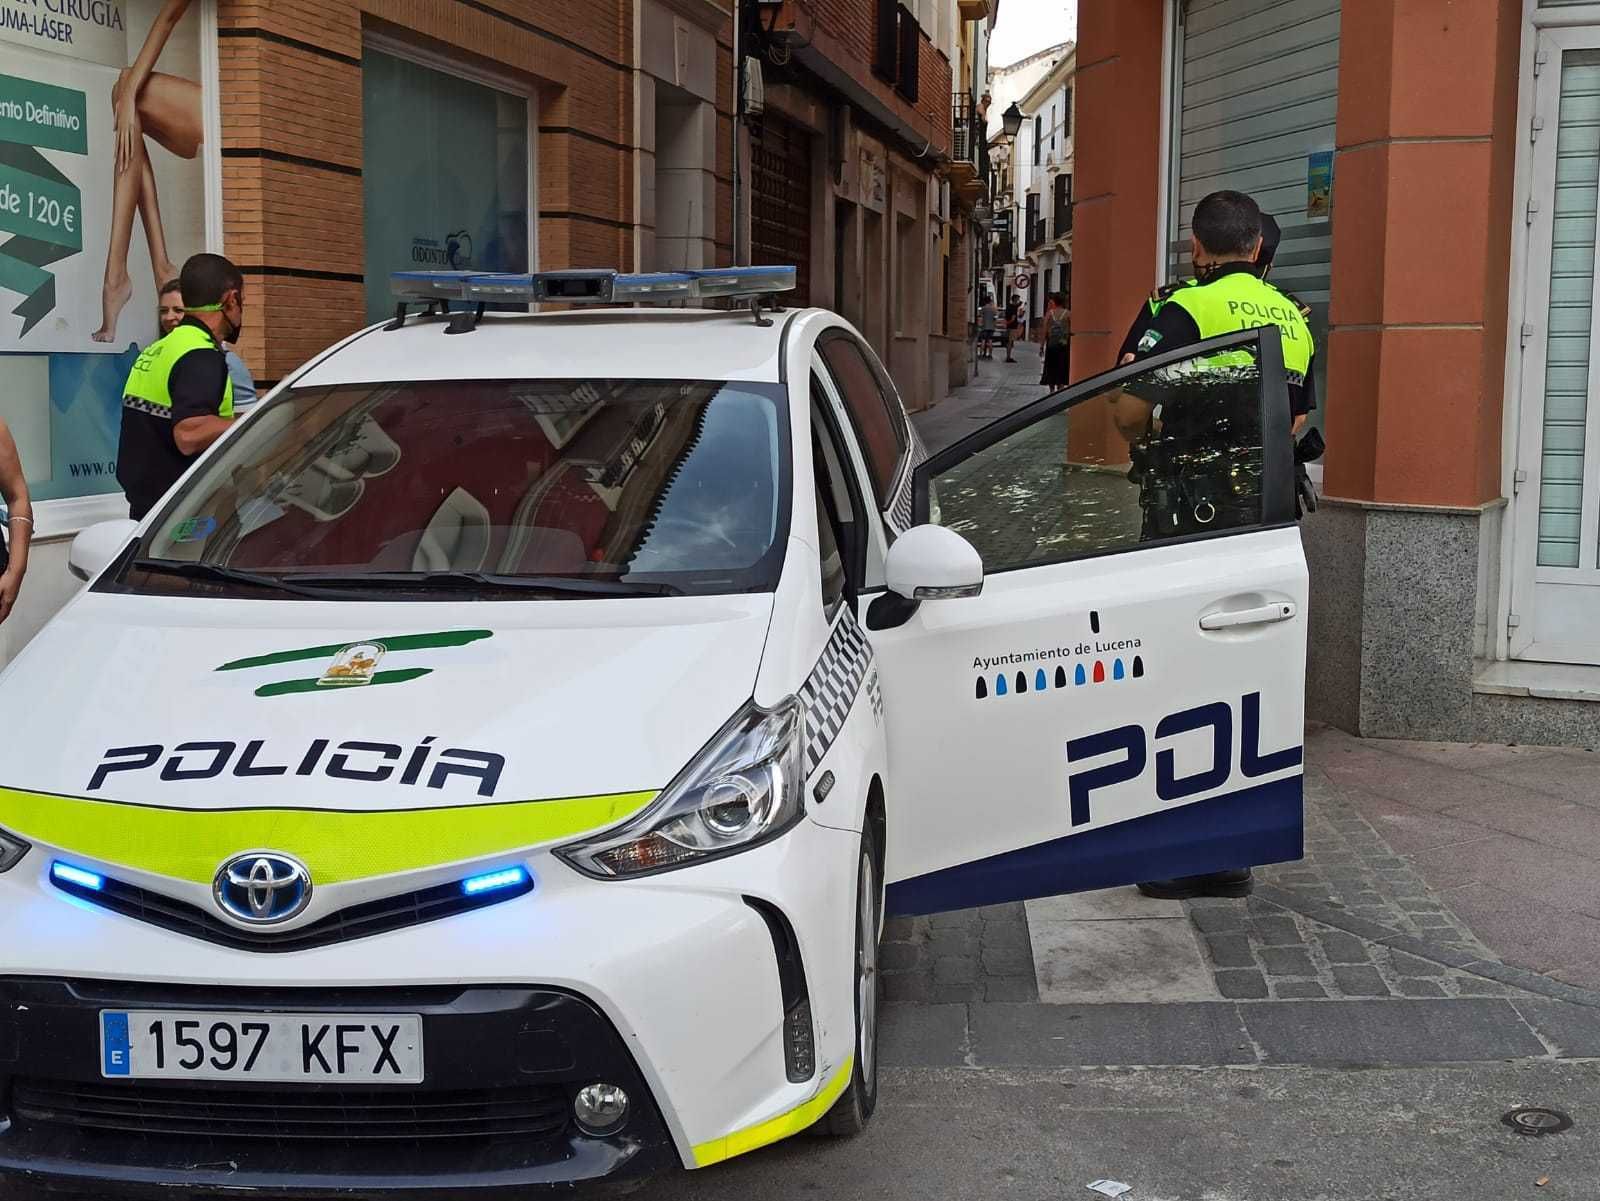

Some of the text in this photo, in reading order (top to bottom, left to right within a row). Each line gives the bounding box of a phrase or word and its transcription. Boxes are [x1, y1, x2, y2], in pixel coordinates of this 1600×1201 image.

[0, 101, 80, 131] nto Definitivo
[1228, 301, 1298, 323] POLICIA
[972, 638, 1142, 670] Ayuntamiento de Lucena
[86, 736, 506, 798] POLICÍA
[1066, 691, 1303, 827] POL
[111, 1020, 402, 1075] E 1597 KFX
